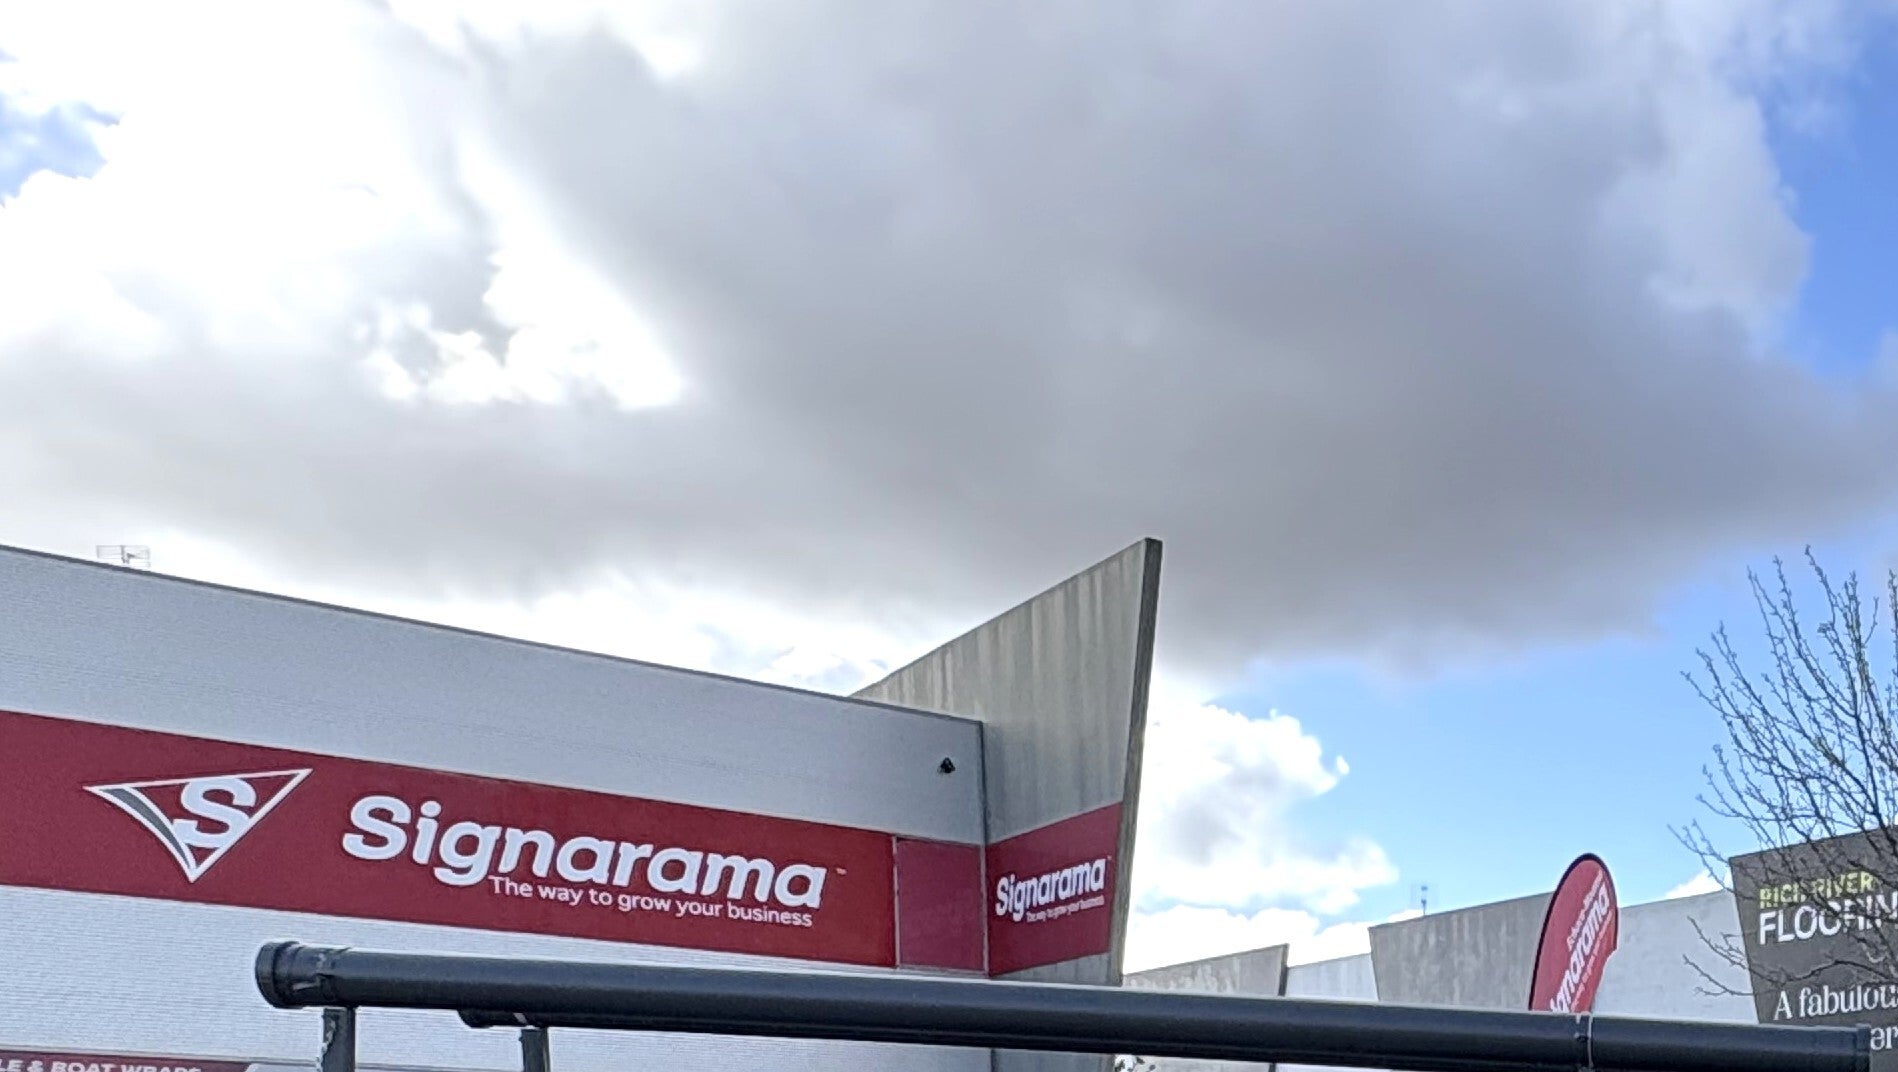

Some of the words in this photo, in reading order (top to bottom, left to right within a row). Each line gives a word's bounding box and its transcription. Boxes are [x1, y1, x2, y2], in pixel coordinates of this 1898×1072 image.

[342, 795, 827, 909] Signarama
[488, 875, 533, 898] The
[538, 886, 584, 906] way
[589, 888, 612, 906] to
[617, 892, 671, 913] grow
[675, 899, 720, 918] your
[727, 901, 813, 928] business
[995, 858, 1106, 922] Signarama
[1813, 871, 1875, 899] RIVER
[1550, 880, 1610, 1014] gnarama
[1774, 991, 1793, 1021] A
